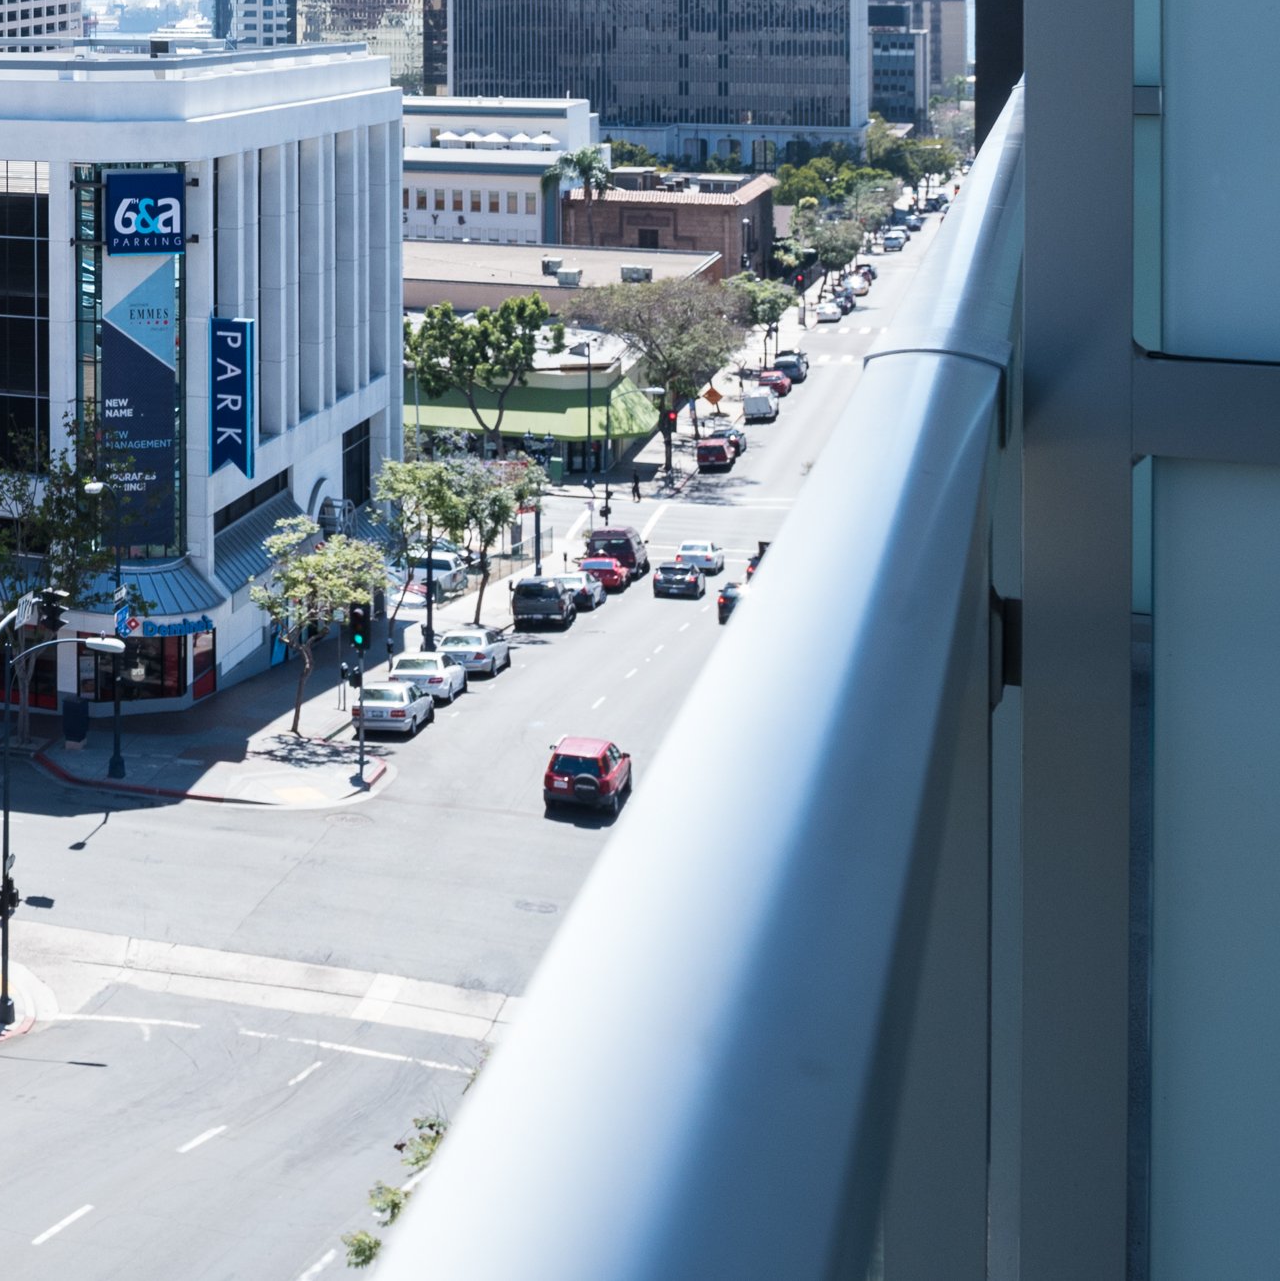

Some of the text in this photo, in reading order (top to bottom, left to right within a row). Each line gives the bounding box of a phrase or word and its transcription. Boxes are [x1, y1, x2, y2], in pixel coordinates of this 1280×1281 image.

[113, 237, 182, 247] PARKING
[129, 308, 169, 320] EMMES
[216, 330, 243, 446] PARK
[105, 398, 128, 407] NEW
[105, 409, 133, 418] NAME
[105, 439, 172, 449] MANAGEMENT
[143, 614, 213, 637] Domino's
